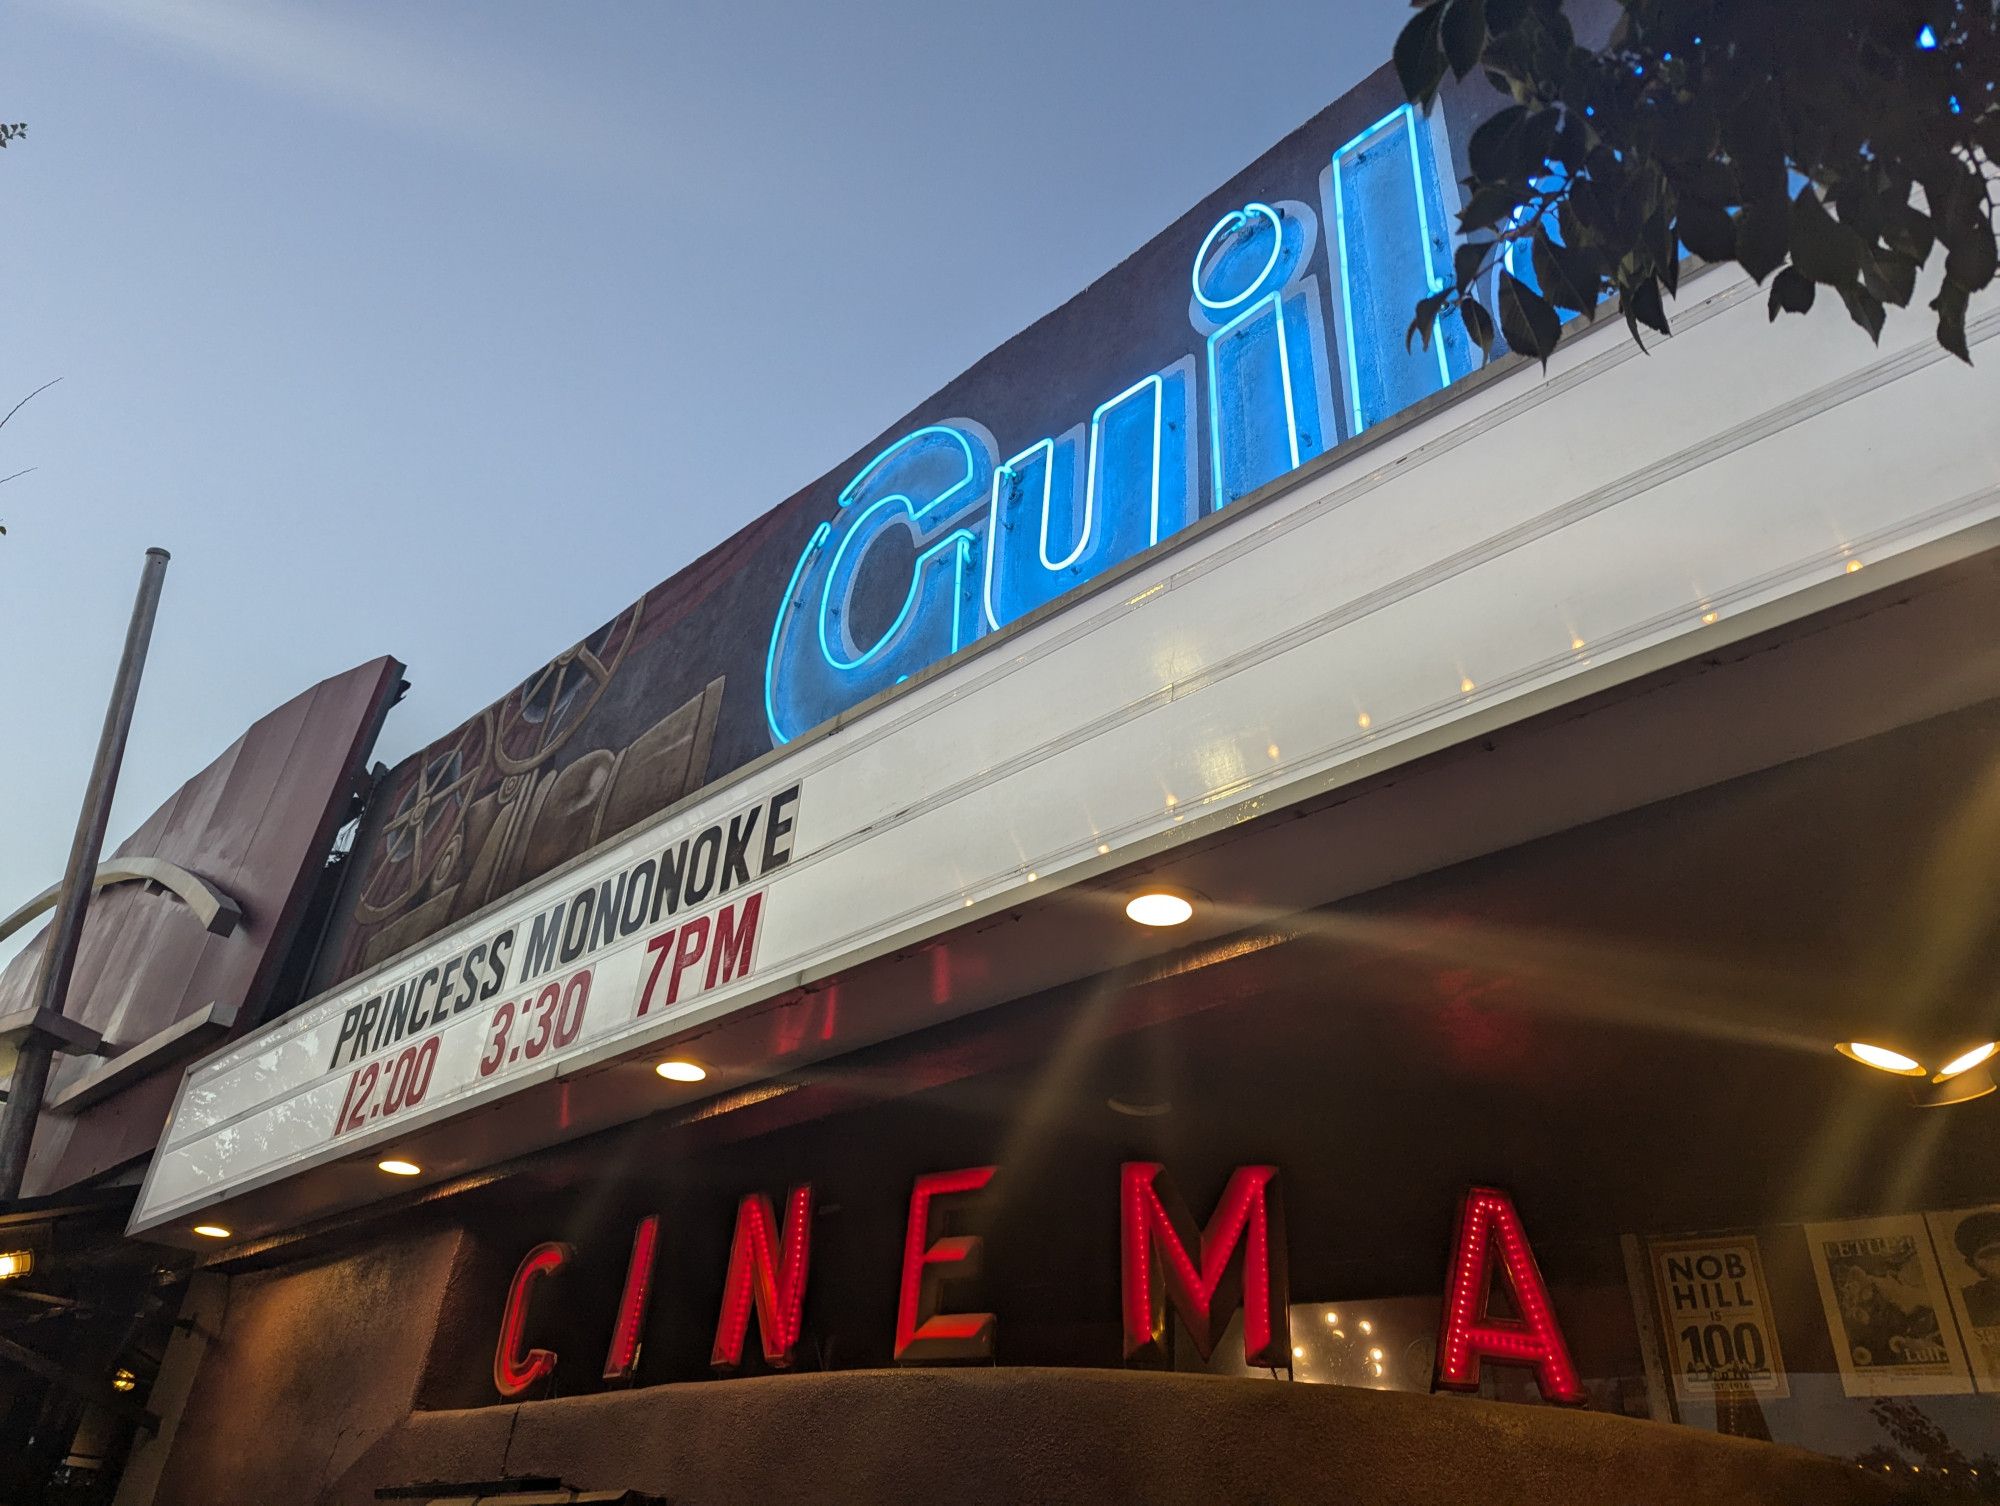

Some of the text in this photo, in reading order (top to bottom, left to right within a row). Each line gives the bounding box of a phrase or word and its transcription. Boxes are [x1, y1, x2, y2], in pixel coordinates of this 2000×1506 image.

[764, 97, 1680, 746] Guil
[329, 785, 801, 1069] PRINCESS MONONOKE
[334, 892, 764, 1137] 12:00 3:30 7PM
[493, 1161, 1588, 1404] CINEMA
[1667, 1253, 1746, 1282] NOB
[1672, 1280, 1753, 1310] HILL
[1710, 1311, 1722, 1321] IS
[1681, 1322, 1766, 1369] 100
